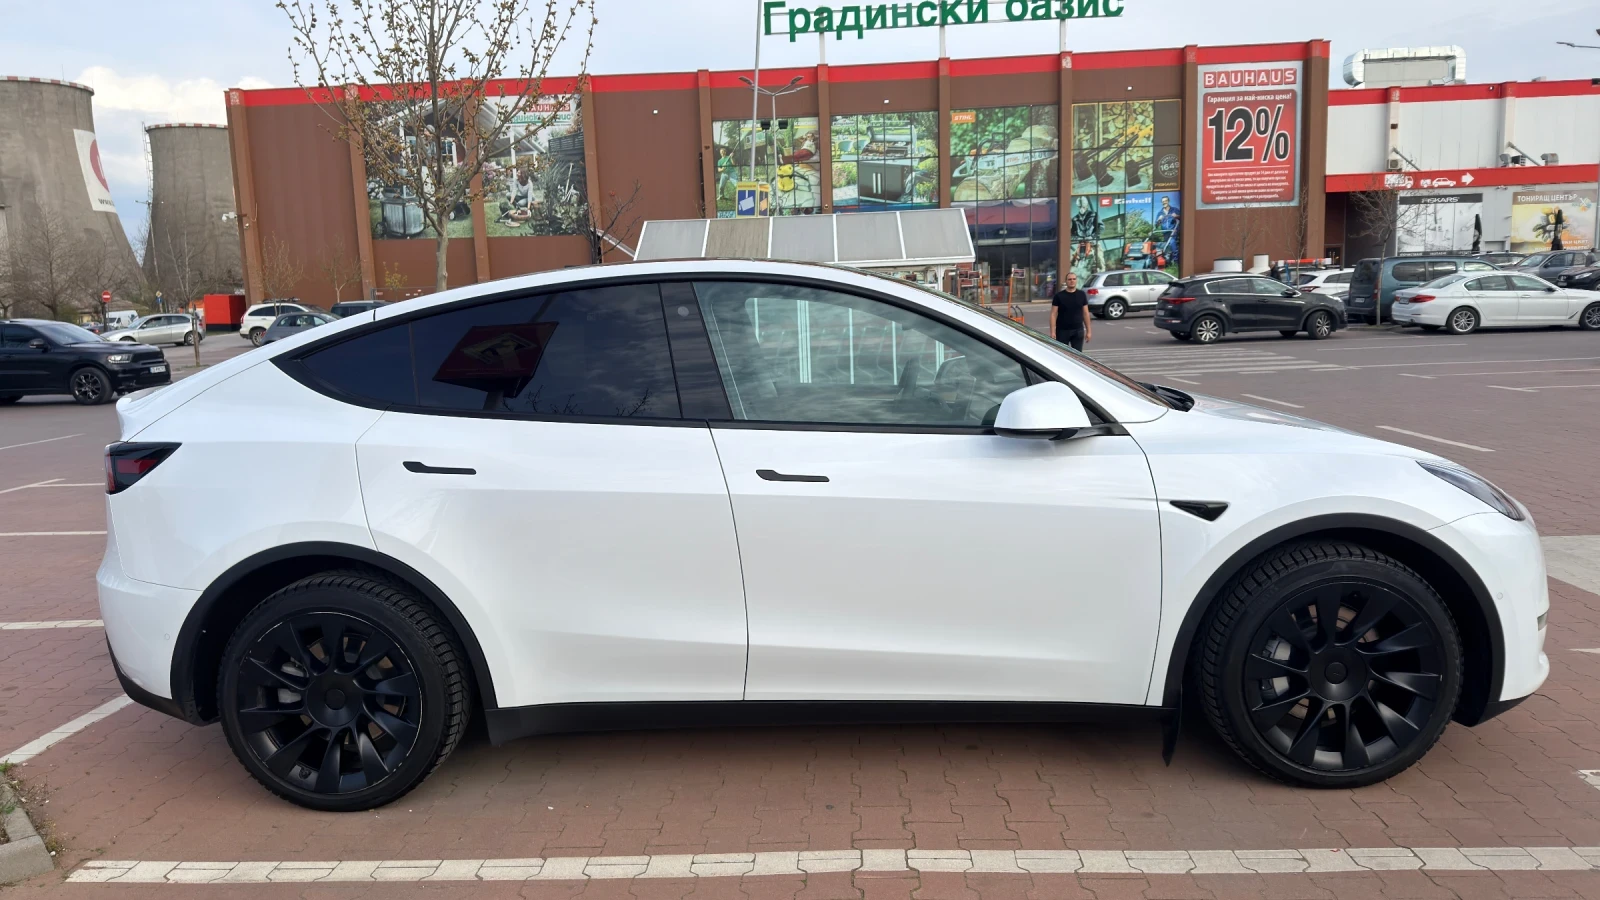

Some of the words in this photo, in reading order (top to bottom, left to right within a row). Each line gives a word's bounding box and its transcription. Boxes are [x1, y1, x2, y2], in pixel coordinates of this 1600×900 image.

[764, 0, 989, 42] Градински
[1005, 0, 1124, 21] оазис
[1204, 69, 1295, 87] BAUHAUS
[1275, 92, 1292, 101] цена!
[1207, 104, 1291, 163] 12%
[1114, 197, 1152, 205] Einhell
[1517, 195, 1551, 203] ТОНИРАЩ
[1551, 193, 1578, 202] ЦЕНТЪР
